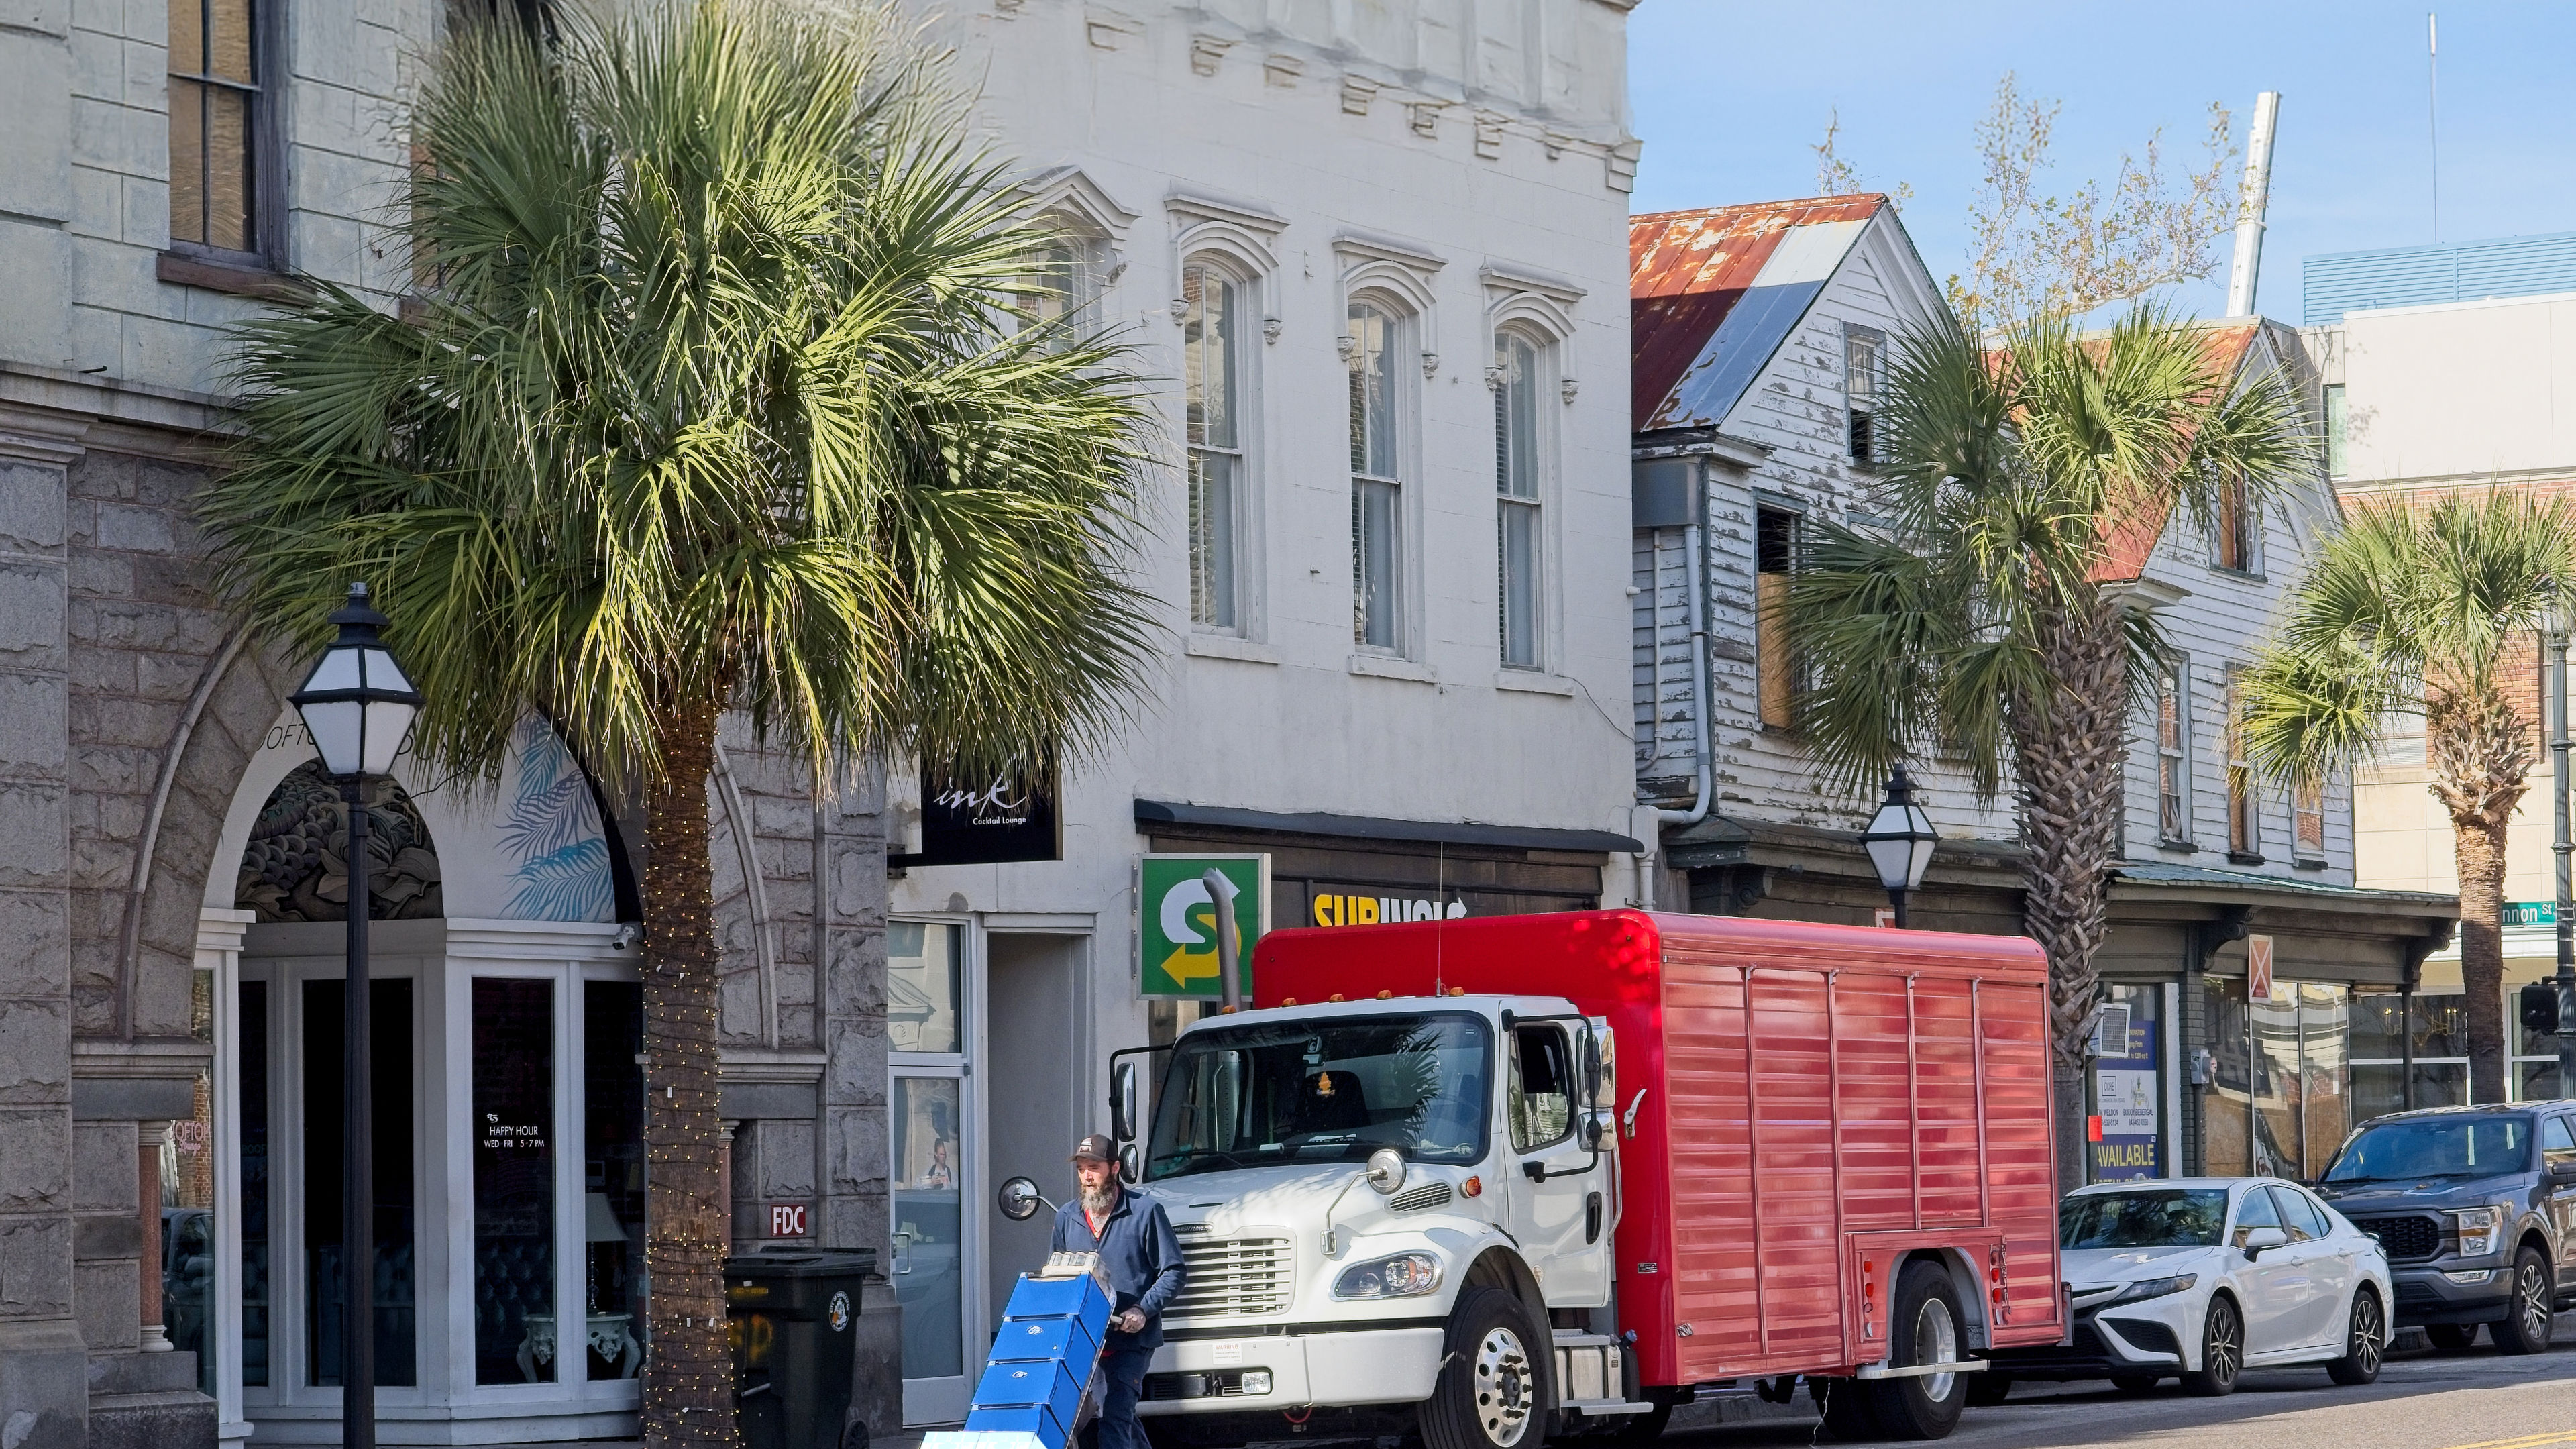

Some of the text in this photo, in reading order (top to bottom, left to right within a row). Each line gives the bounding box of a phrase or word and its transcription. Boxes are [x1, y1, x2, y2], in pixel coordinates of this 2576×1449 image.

[973, 816, 1026, 825] Cocktail Lounge
[2502, 904, 2552, 922] nnon St
[174, 1122, 210, 1140] OFTOP
[490, 1126, 538, 1136] HAPPY HOUR
[484, 1140, 500, 1148] WED
[504, 1140, 513, 1148] FRI
[535, 1140, 545, 1148] PM
[2098, 1144, 2155, 1167] AVAILABLE
[773, 1206, 804, 1234] FDC
